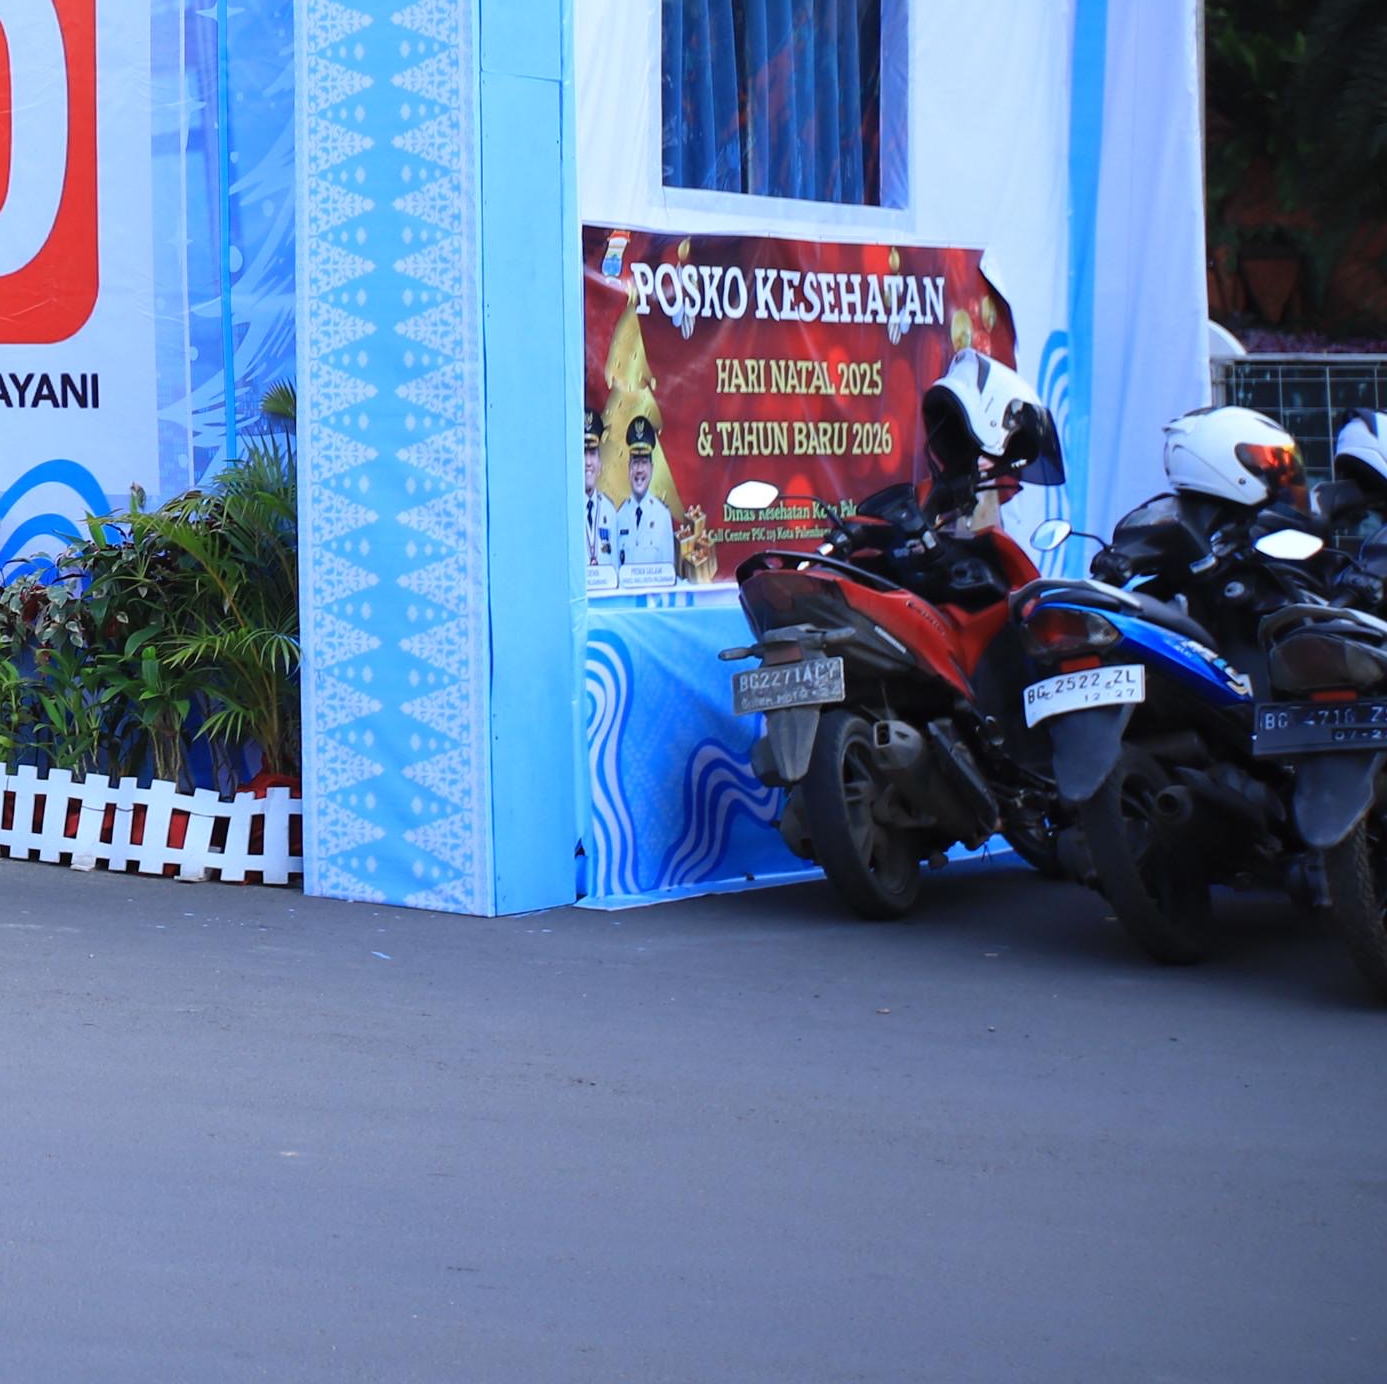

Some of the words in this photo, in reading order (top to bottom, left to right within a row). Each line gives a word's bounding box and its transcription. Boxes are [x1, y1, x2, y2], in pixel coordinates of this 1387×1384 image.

[630, 262, 748, 319] POSKO
[754, 268, 946, 324] KESEHATAN
[716, 359, 766, 394] HARI
[770, 360, 835, 395] NATAL
[839, 360, 883, 396] 2025
[697, 422, 714, 456] &
[717, 422, 789, 456] TAHUN
[793, 422, 847, 456] BARU
[852, 421, 892, 455] 2026
[723, 504, 755, 522] Dinas
[1055, 673, 1100, 693] 2522
